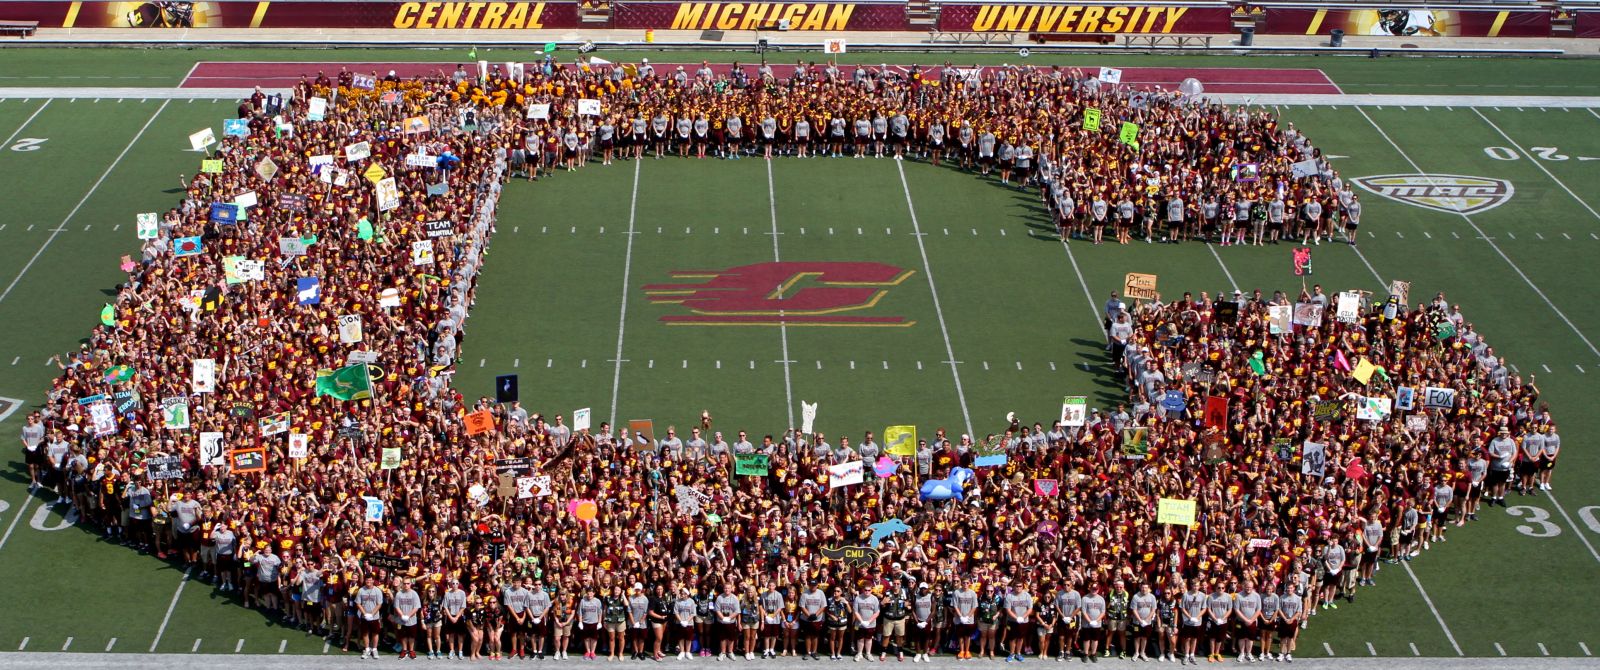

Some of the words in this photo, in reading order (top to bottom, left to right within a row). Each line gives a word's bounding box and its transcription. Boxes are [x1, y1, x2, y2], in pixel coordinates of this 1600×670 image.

[393, 2, 545, 29] CENTRAL
[670, 3, 855, 31] MICHIGAN
[972, 5, 1187, 34] UNIVERSITY
[353, 75, 374, 88] PIG
[427, 222, 450, 230] TEAM
[242, 260, 259, 269] Team
[340, 315, 359, 327] LION
[115, 391, 132, 399] TEAM
[1430, 390, 1452, 406] FOX
[1164, 502, 1190, 512] TEAM
[845, 549, 864, 558] CMU
